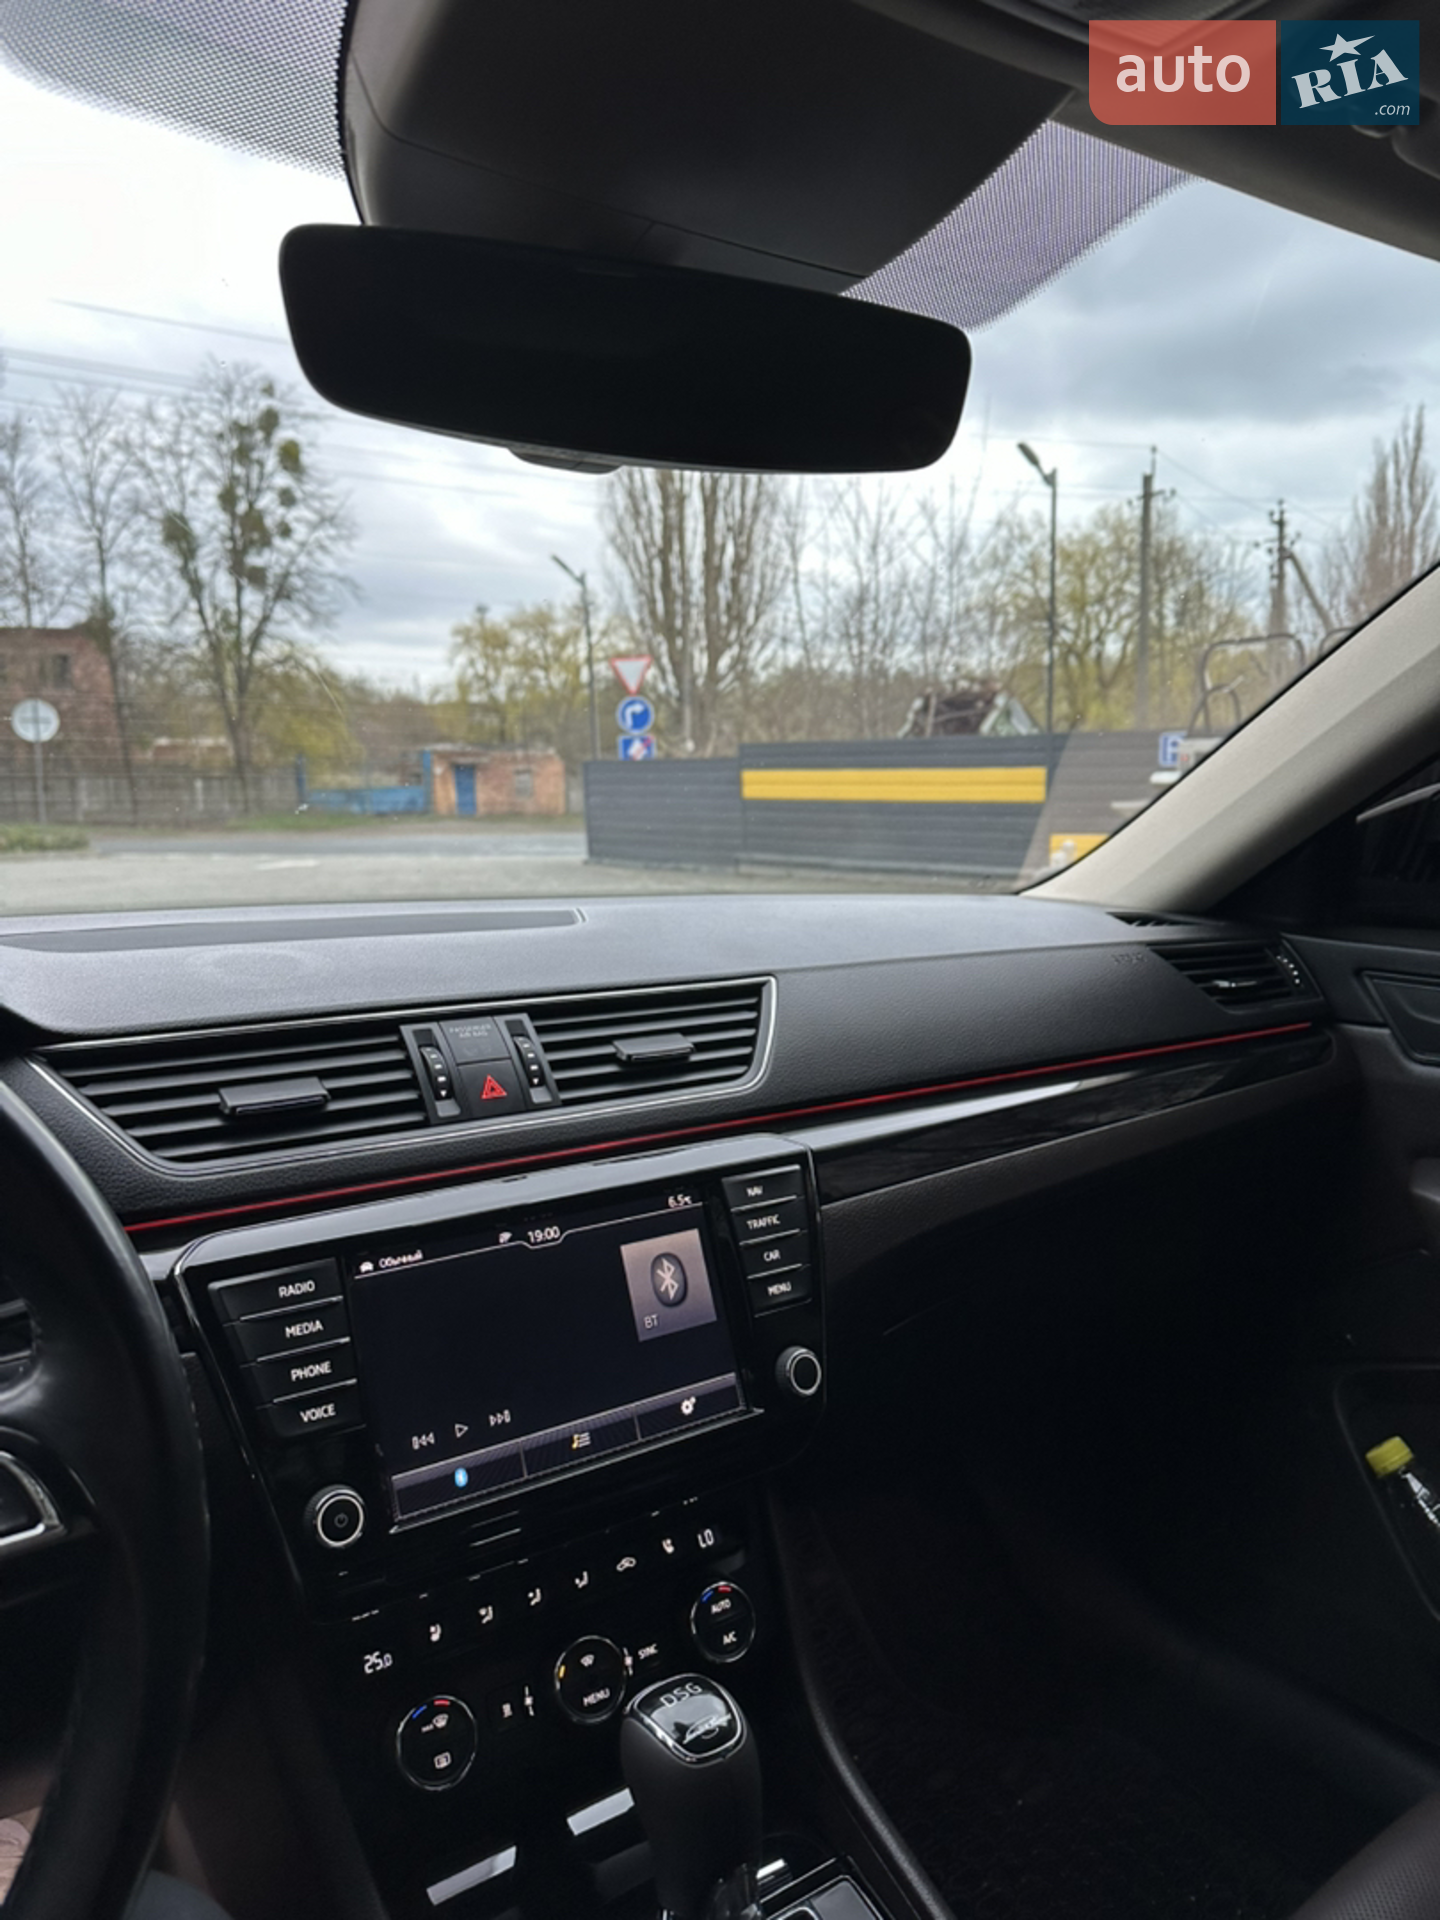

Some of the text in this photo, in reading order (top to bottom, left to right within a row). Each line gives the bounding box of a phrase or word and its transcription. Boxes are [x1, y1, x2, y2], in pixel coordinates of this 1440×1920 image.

[745, 1184, 764, 1198] NAV
[746, 1213, 781, 1230] TRAFFIC
[527, 1225, 561, 1244] 19:00
[763, 1248, 781, 1262] CAR
[278, 1279, 316, 1299] RADIO
[767, 1281, 792, 1297] MENU
[285, 1319, 324, 1339] MEDIA
[644, 1313, 660, 1330] BT
[291, 1361, 332, 1382] PHONE
[299, 1403, 336, 1423] VOICE
[711, 1598, 732, 1615] AUTO
[637, 1643, 659, 1661] SYNC
[363, 1651, 394, 1675] 25.0
[583, 1687, 611, 1708] MENU
[659, 1681, 704, 1709] DSG
